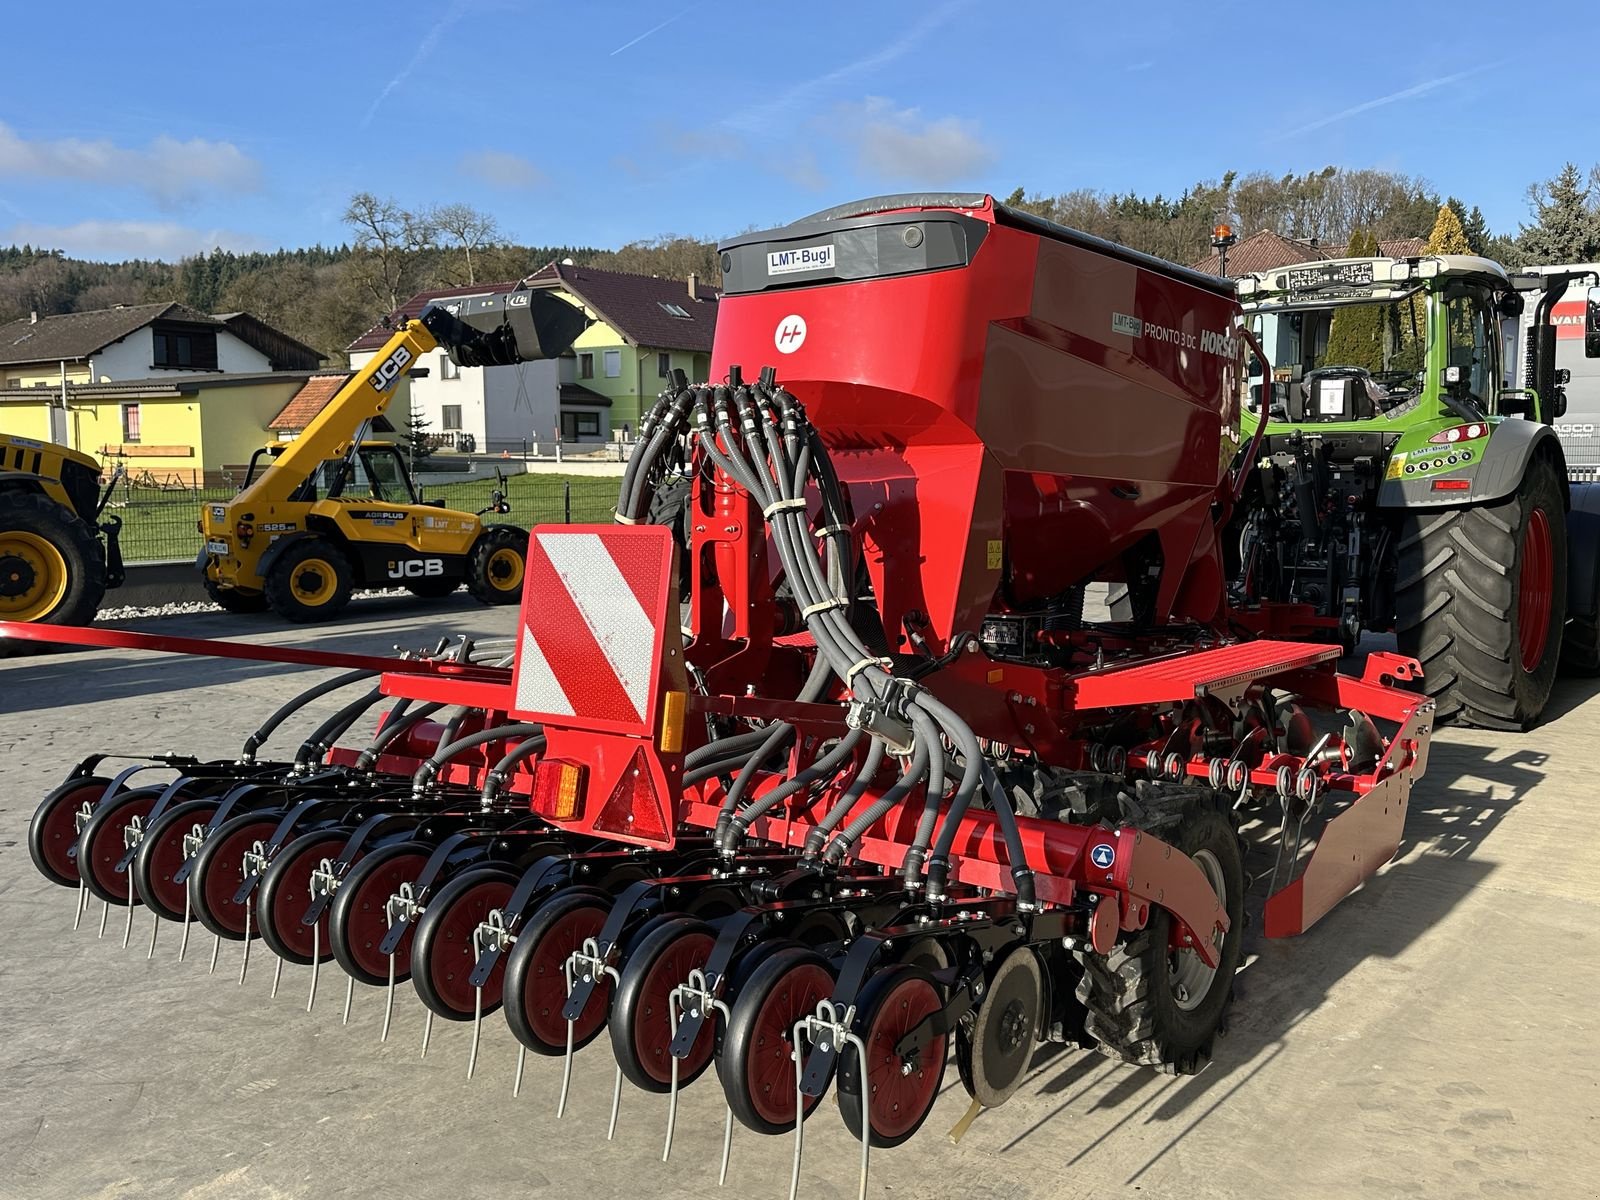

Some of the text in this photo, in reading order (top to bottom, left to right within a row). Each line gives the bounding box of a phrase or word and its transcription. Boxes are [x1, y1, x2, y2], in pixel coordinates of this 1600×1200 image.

[771, 246, 831, 267] LMT-Bugl
[1552, 315, 1586, 325] VALT
[1144, 322, 1197, 349] PRONTO 3 DC
[1200, 329, 1240, 361] HORSCH
[374, 346, 411, 390] JCB
[388, 559, 444, 578] JCB
